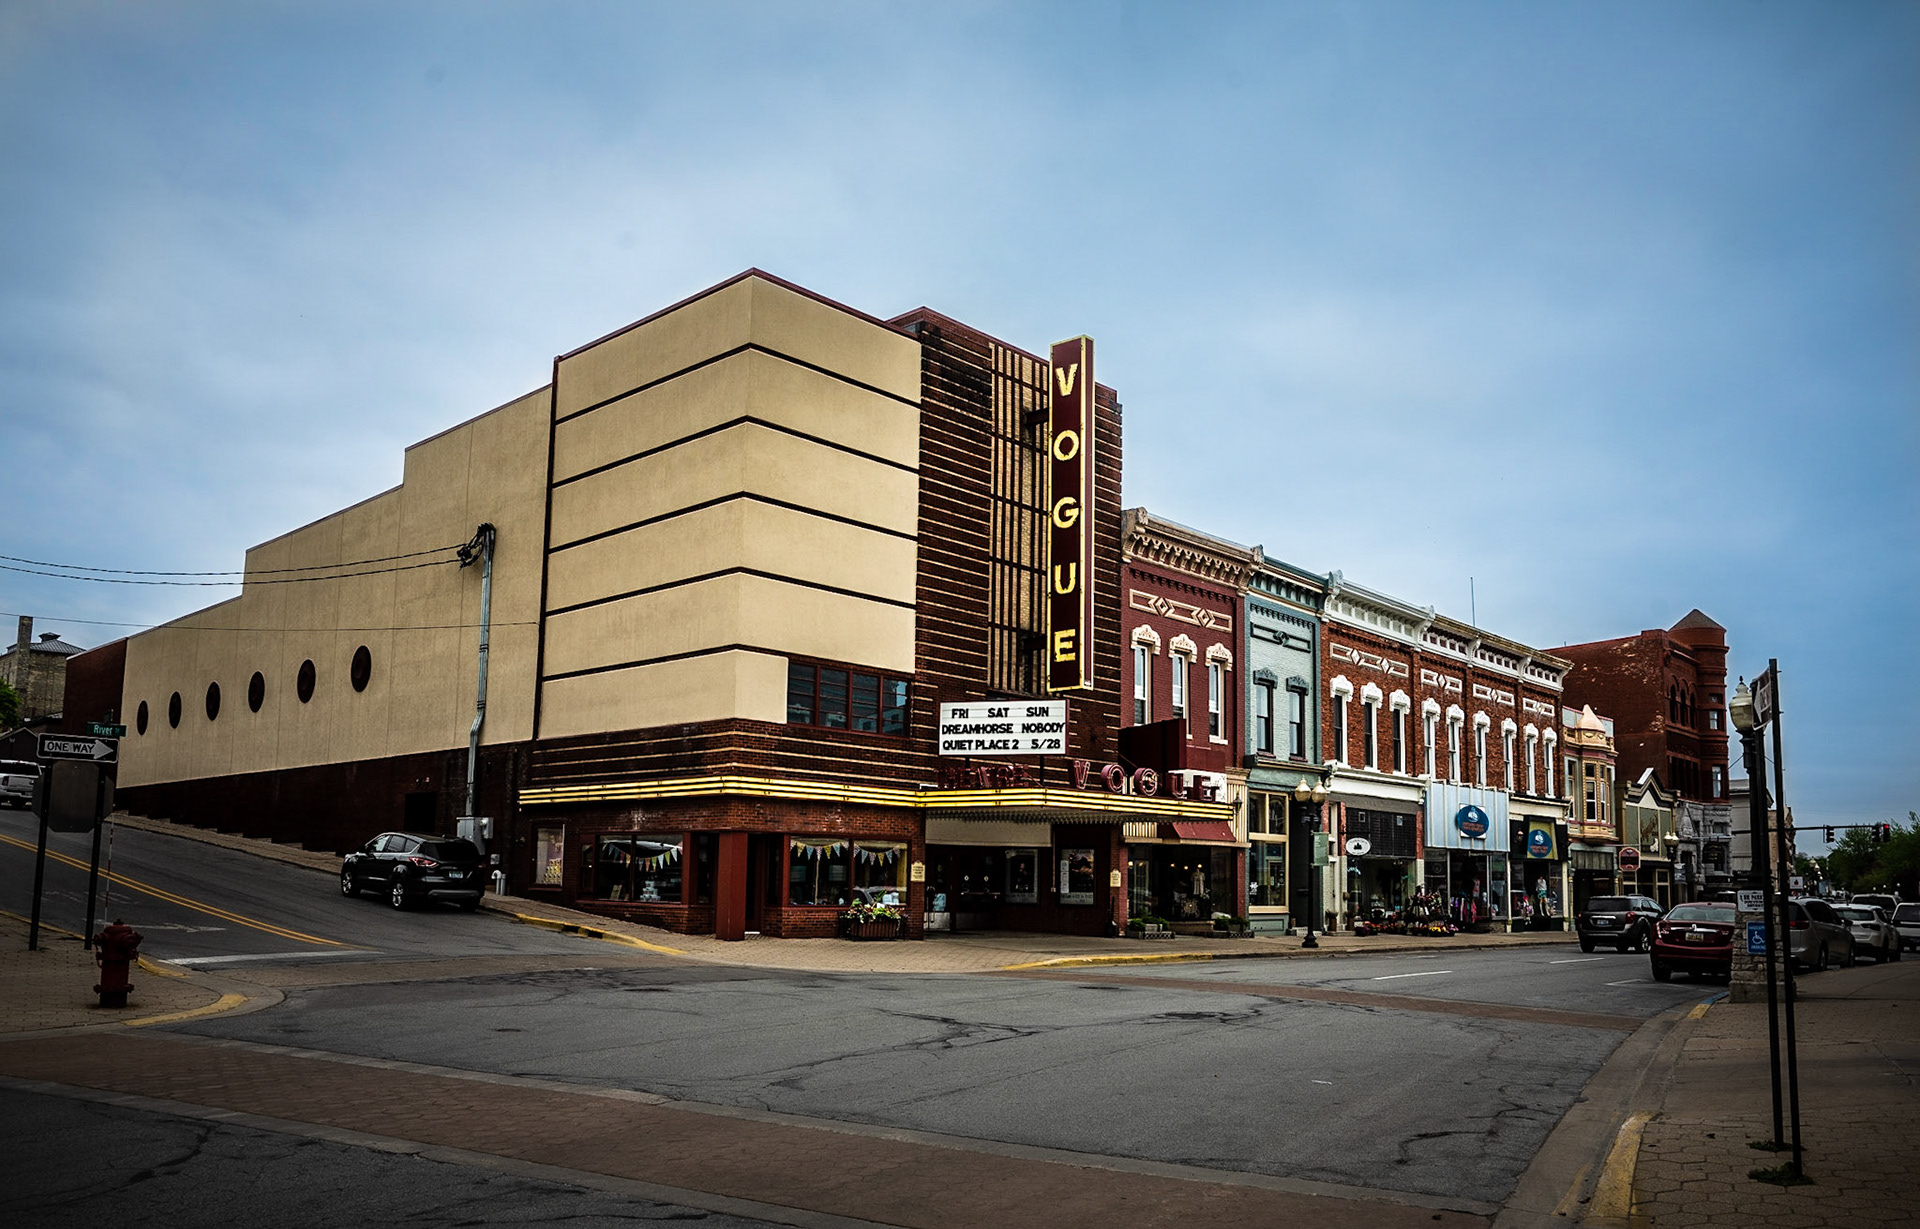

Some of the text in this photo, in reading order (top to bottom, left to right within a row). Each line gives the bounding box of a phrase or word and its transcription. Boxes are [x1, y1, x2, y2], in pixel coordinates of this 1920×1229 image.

[1052, 362, 1080, 663] VOGUE
[951, 706, 1049, 719] FRI SAT SUN
[93, 724, 113, 735] River
[942, 722, 1065, 735] DREAMHORSE NOBODY
[47, 741, 95, 754] ONE WAY
[943, 738, 1061, 750] QUIET PLACE 2 5/28
[1069, 760, 1220, 802] VOGUE
